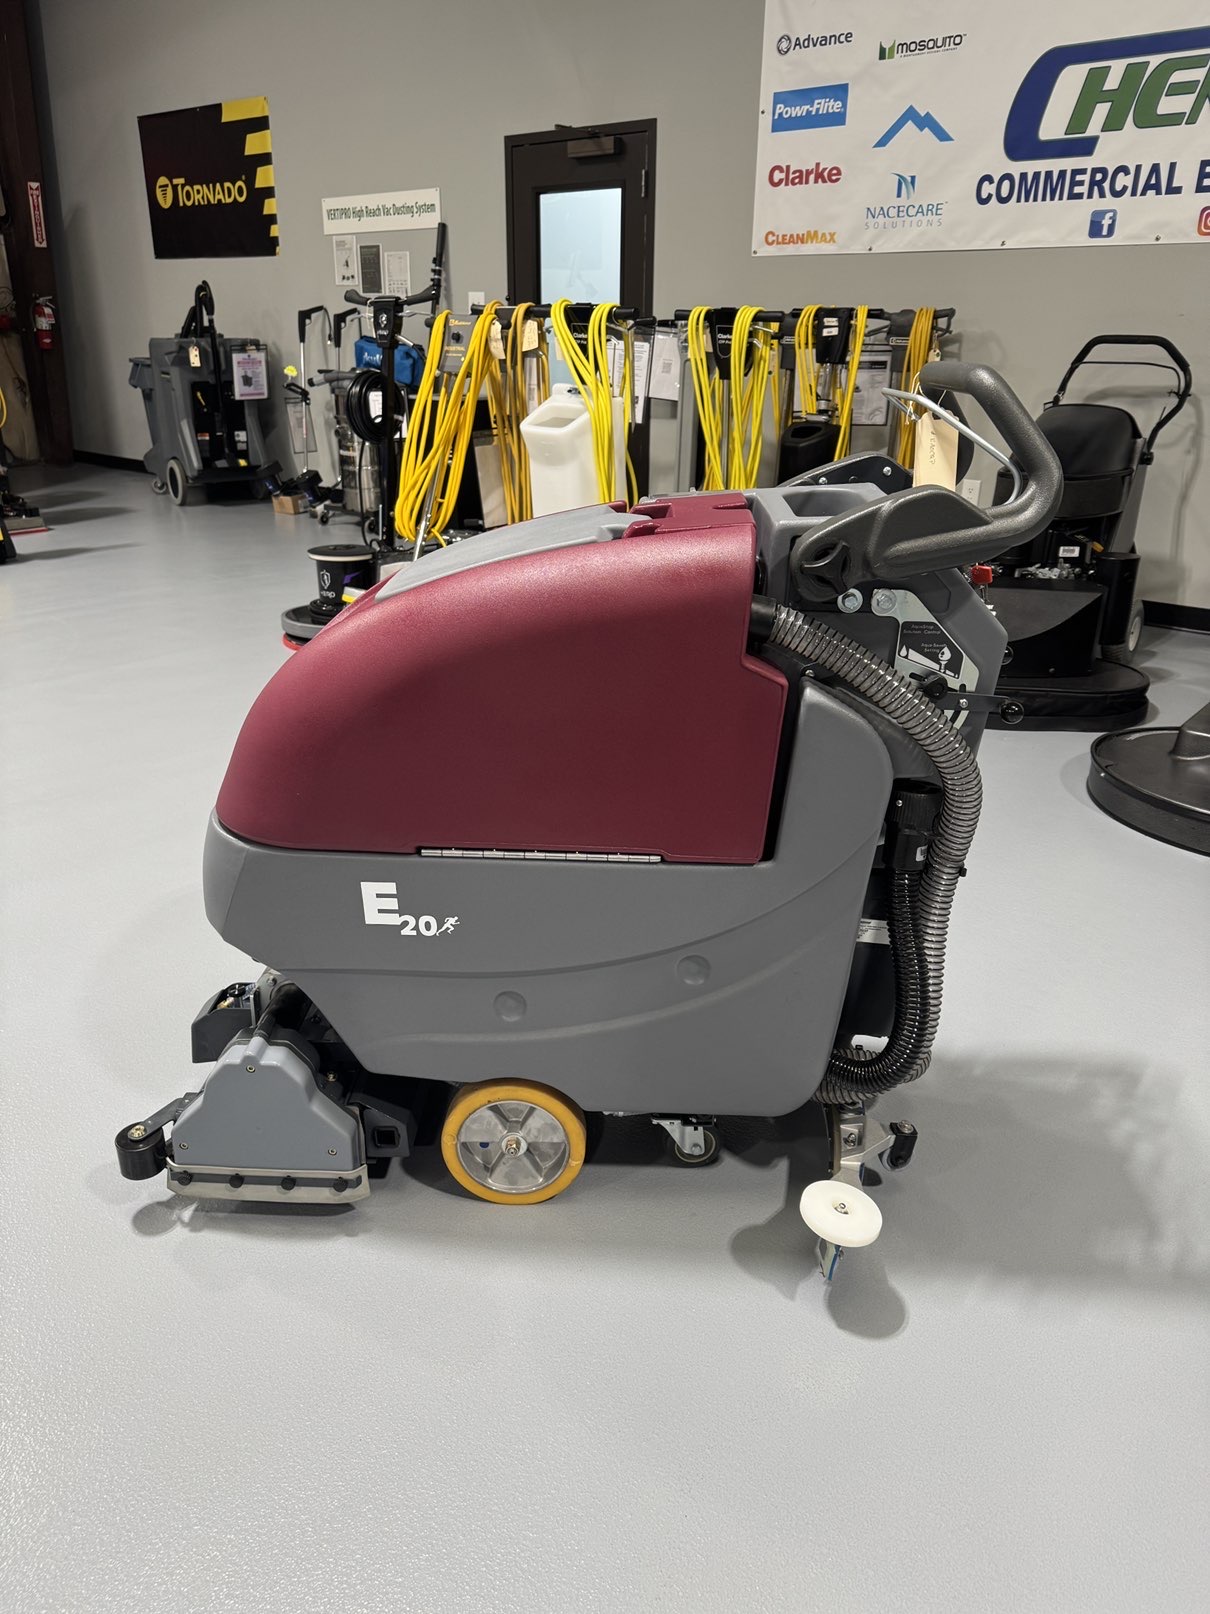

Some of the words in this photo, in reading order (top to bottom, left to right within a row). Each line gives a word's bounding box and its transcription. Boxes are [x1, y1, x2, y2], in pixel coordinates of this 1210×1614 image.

[792, 31, 853, 51] Advance
[774, 98, 843, 119] Powr-Flite
[768, 162, 842, 188] Clarke
[975, 161, 1183, 205] COMMERCIAL
[172, 178, 247, 207] TORNADO
[326, 207, 351, 221] VERTIPRO
[352, 205, 364, 221] High
[365, 204, 381, 218] Reach
[381, 204, 392, 216] Vac
[393, 203, 414, 218] Dusting
[415, 201, 436, 217] System
[866, 202, 944, 219] NACECARE
[864, 218, 943, 230] SOLUTIONS
